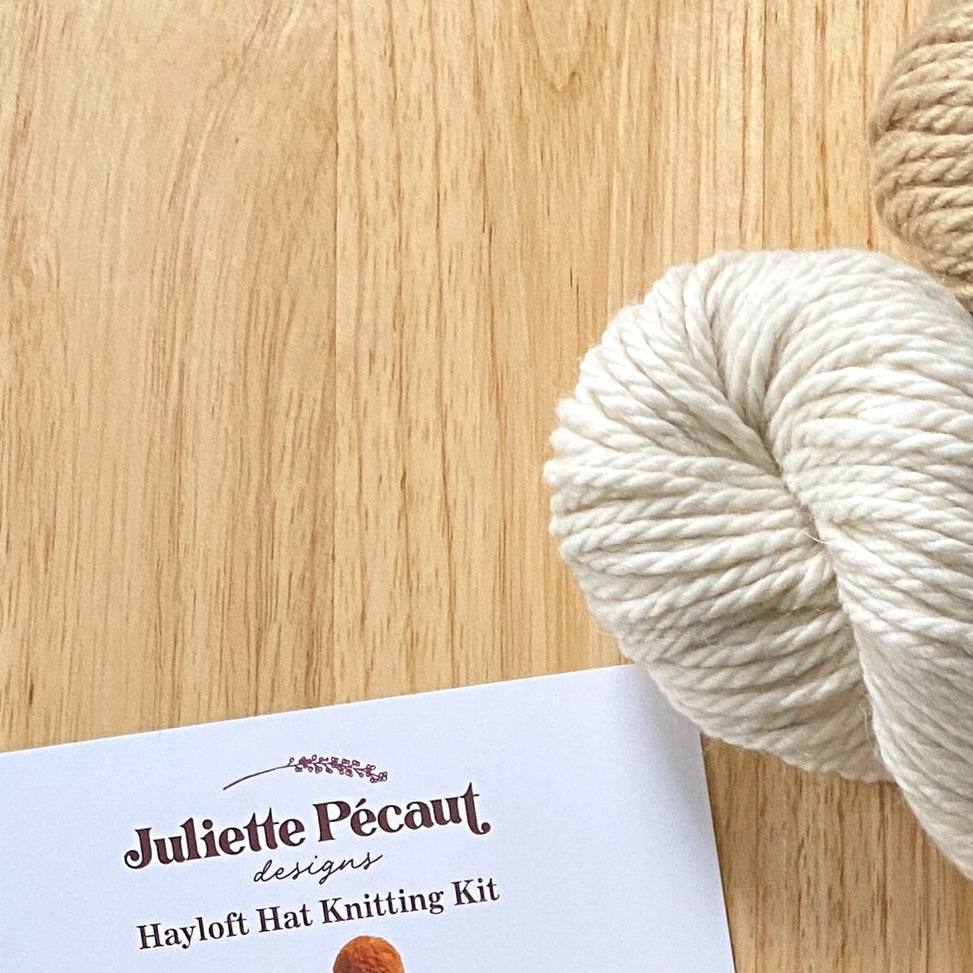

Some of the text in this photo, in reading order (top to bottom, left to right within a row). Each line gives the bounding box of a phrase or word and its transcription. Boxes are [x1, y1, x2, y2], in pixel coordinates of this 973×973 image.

[123, 781, 492, 870] Juliette Pécaut
[252, 851, 384, 885] designs
[135, 877, 501, 950] Hayloft Hat Knitting Kit
